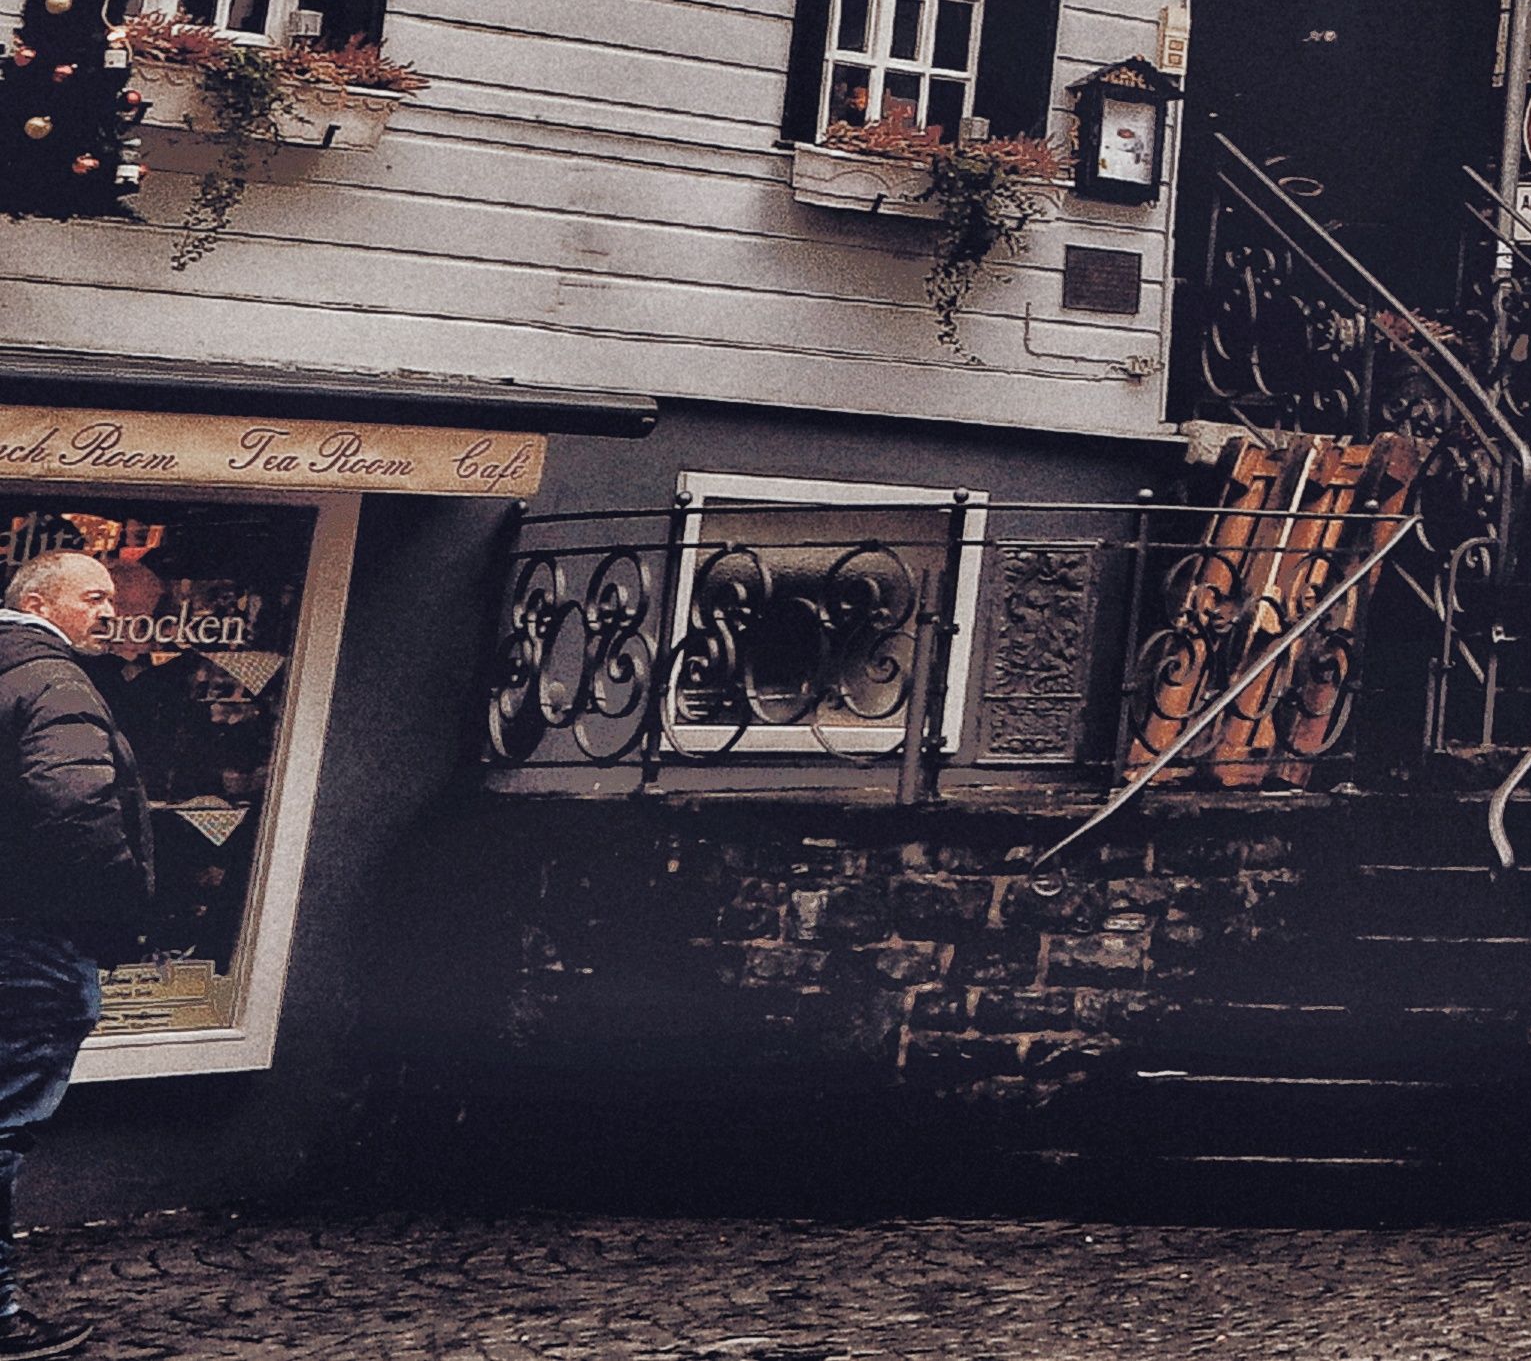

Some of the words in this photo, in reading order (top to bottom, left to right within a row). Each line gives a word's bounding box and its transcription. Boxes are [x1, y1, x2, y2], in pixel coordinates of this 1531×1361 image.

[59, 422, 179, 472] Room
[229, 428, 301, 473] Tea
[308, 431, 414, 477] Room
[452, 437, 532, 491] Café
